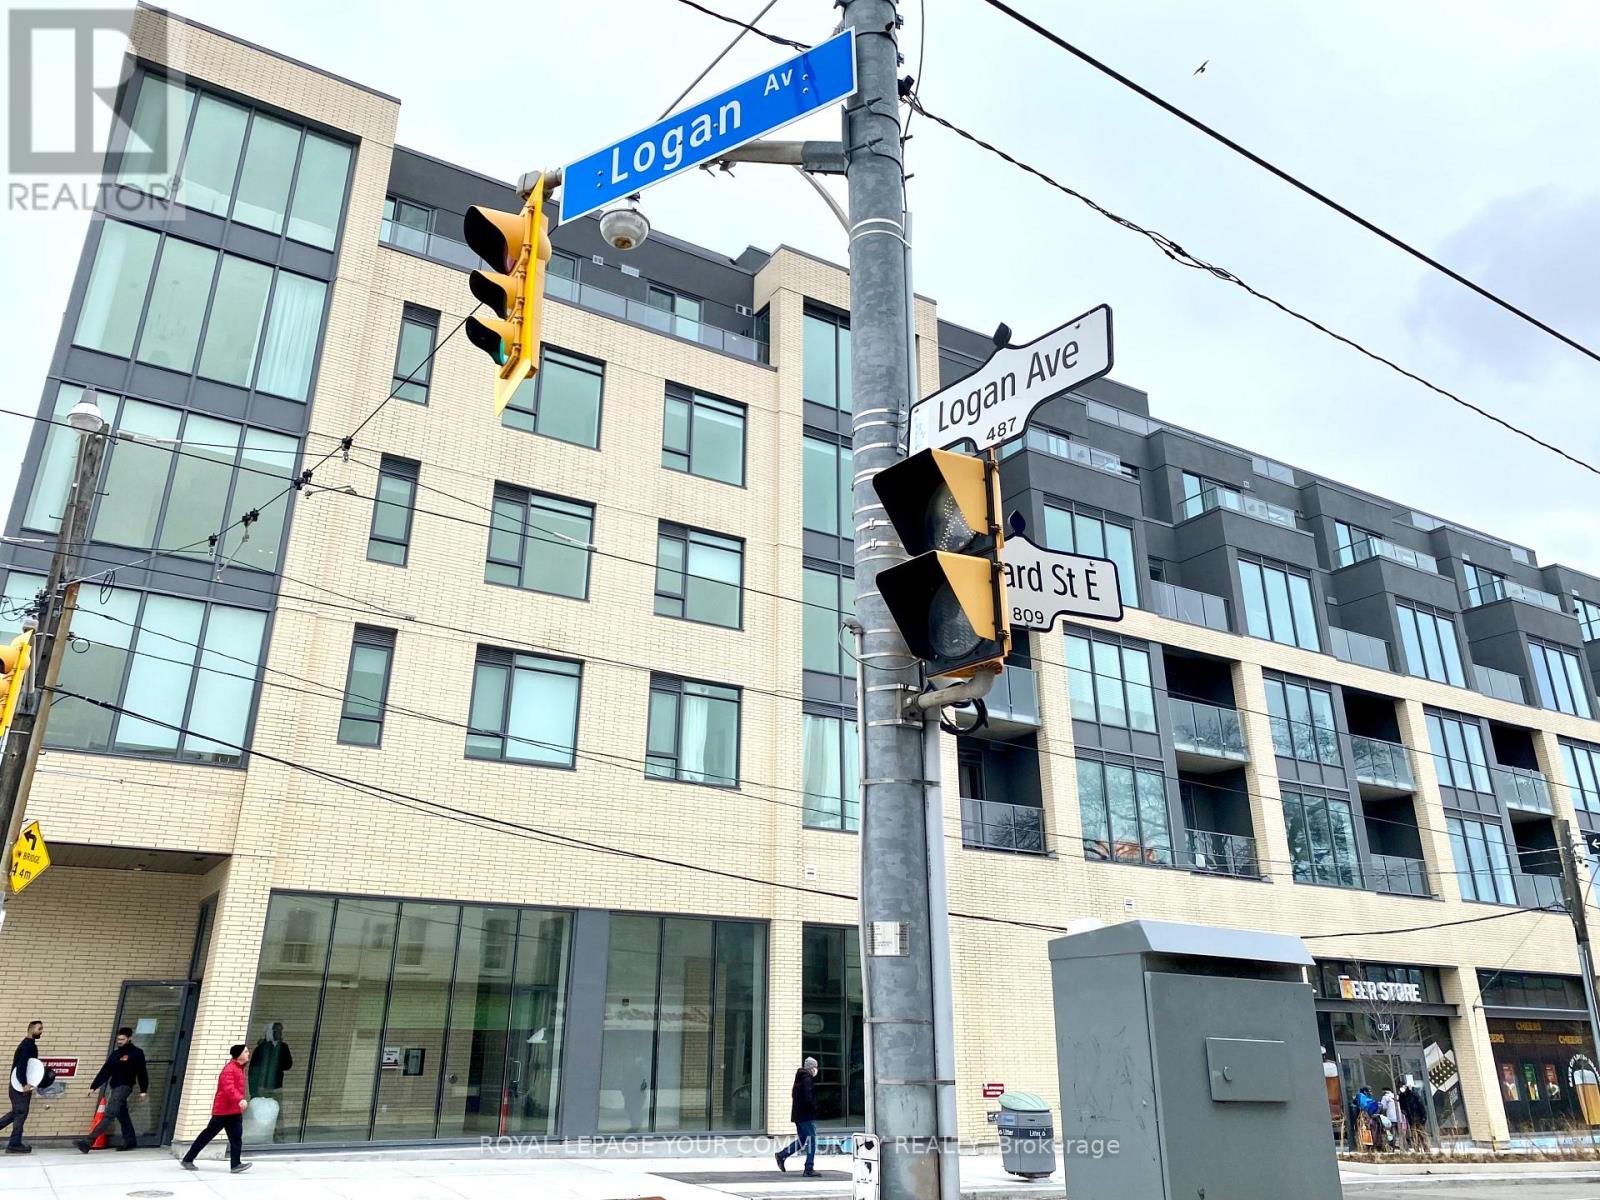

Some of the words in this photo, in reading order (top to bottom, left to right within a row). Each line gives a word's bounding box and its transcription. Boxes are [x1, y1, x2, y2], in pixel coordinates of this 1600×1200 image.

[610, 98, 742, 185] Logan
[763, 67, 794, 97] Av
[937, 371, 1016, 433] Logan
[1025, 339, 1080, 390] Ave
[985, 416, 1018, 441] 487
[1003, 560, 1044, 593] ard
[1051, 563, 1078, 599] St
[1084, 568, 1101, 602] E
[1012, 606, 1045, 625] 809
[1378, 981, 1422, 1002] STORE
